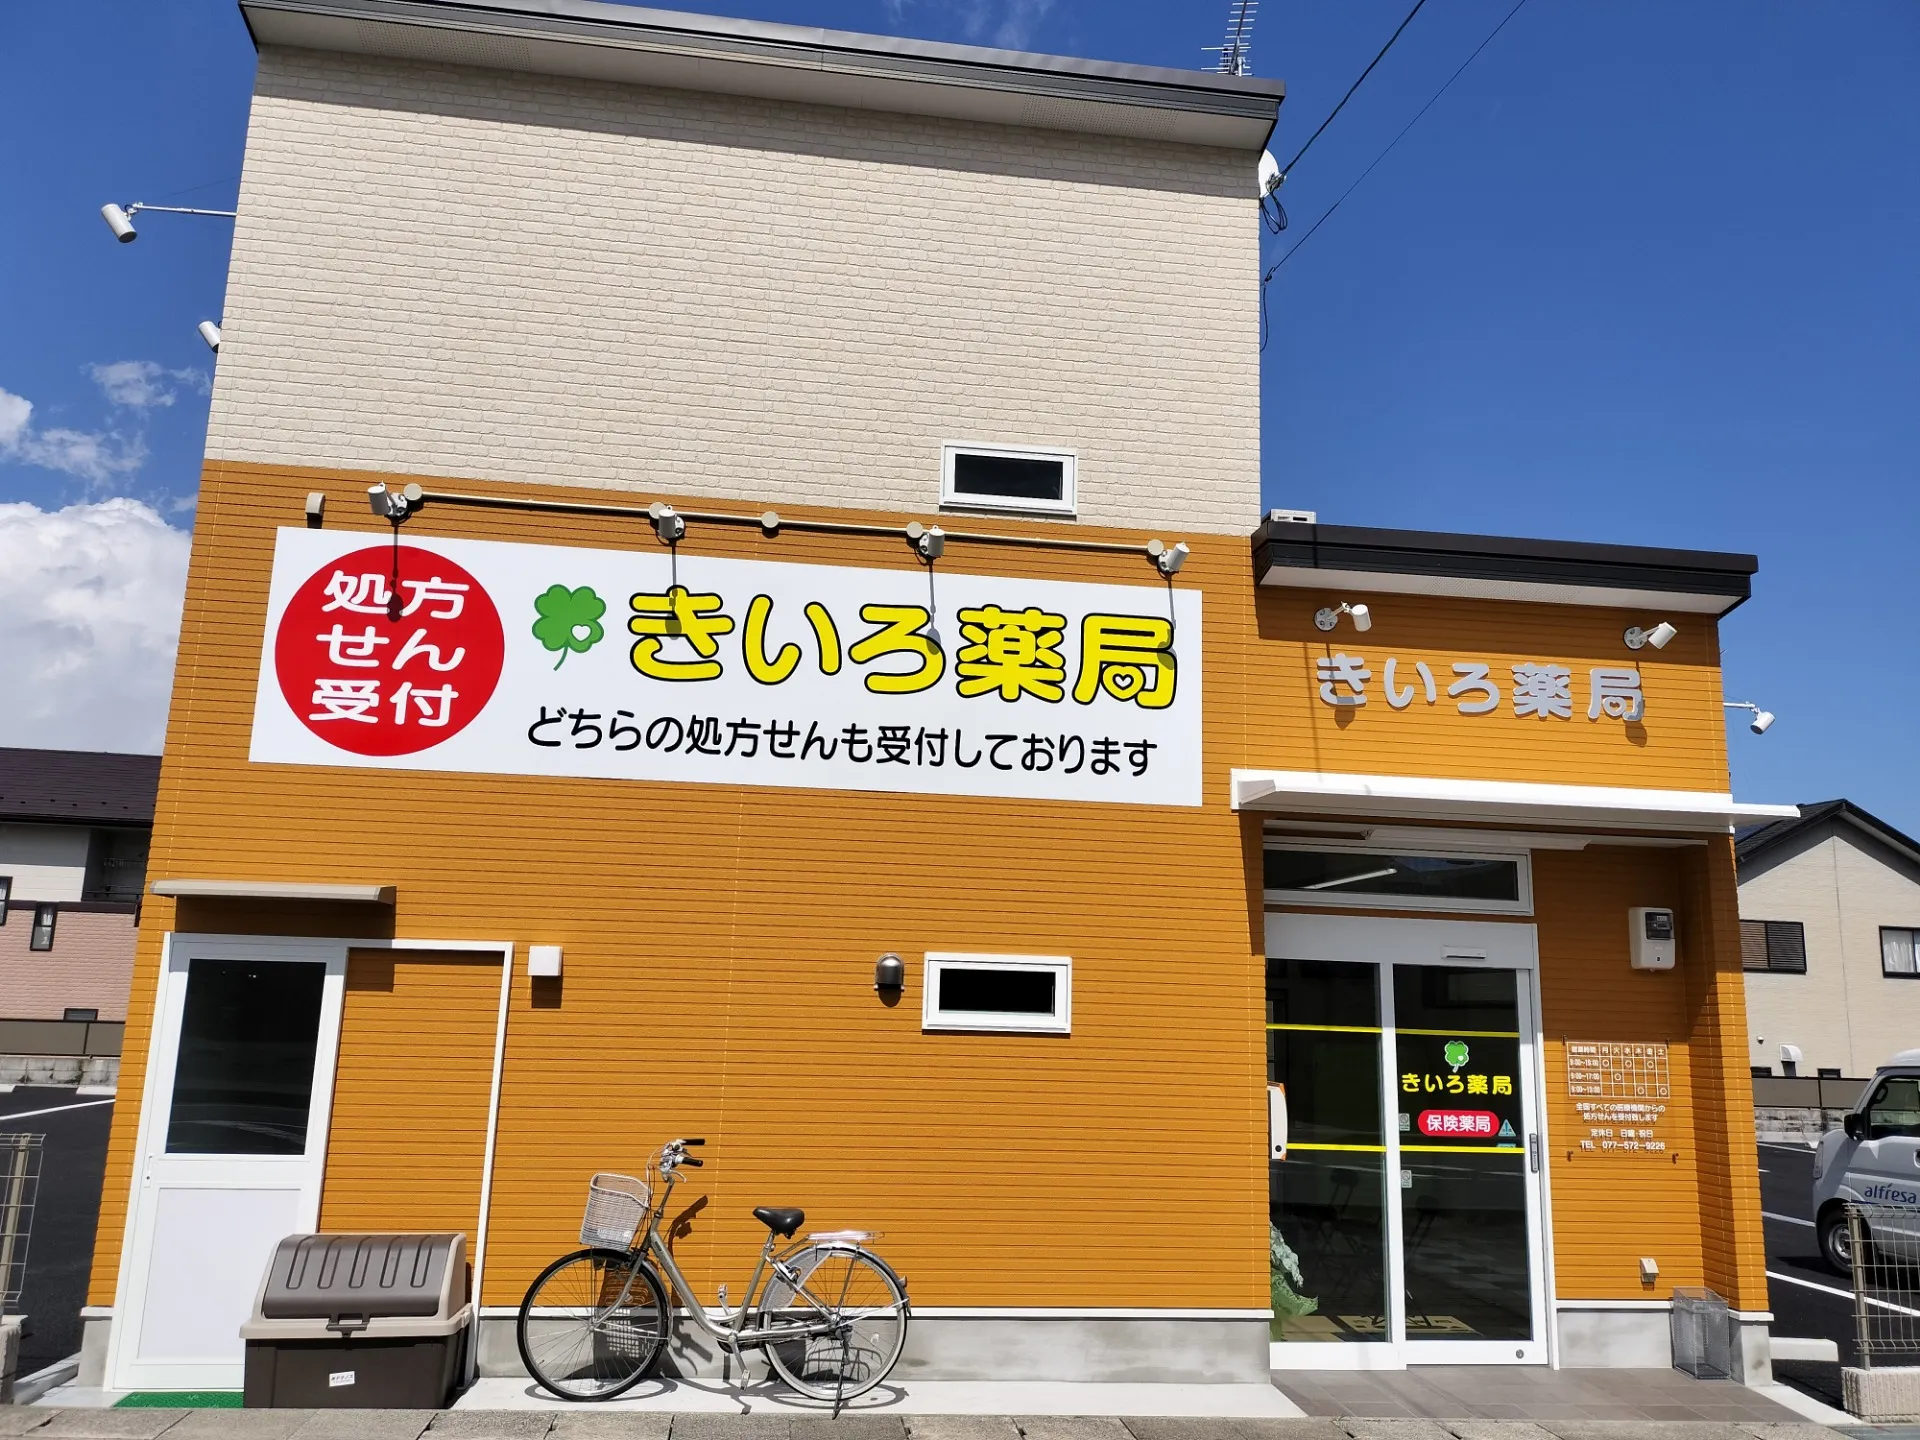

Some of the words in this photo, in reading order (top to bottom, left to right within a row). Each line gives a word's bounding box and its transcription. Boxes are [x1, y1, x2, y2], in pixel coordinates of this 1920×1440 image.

[323, 570, 469, 619] 処方
[316, 624, 466, 671] せん
[627, 584, 1177, 709] きいろ薬局
[309, 678, 459, 727] 受付
[1316, 653, 1644, 722] きいろ薬局
[528, 706, 1157, 776] どちらの処方せんも受付しております
[1402, 1073, 1512, 1095] きいろ薬局
[1426, 1114, 1491, 1132] 保険薬局
[1580, 1140, 1596, 1149] TEL
[1864, 1183, 1917, 1204] alfresa
